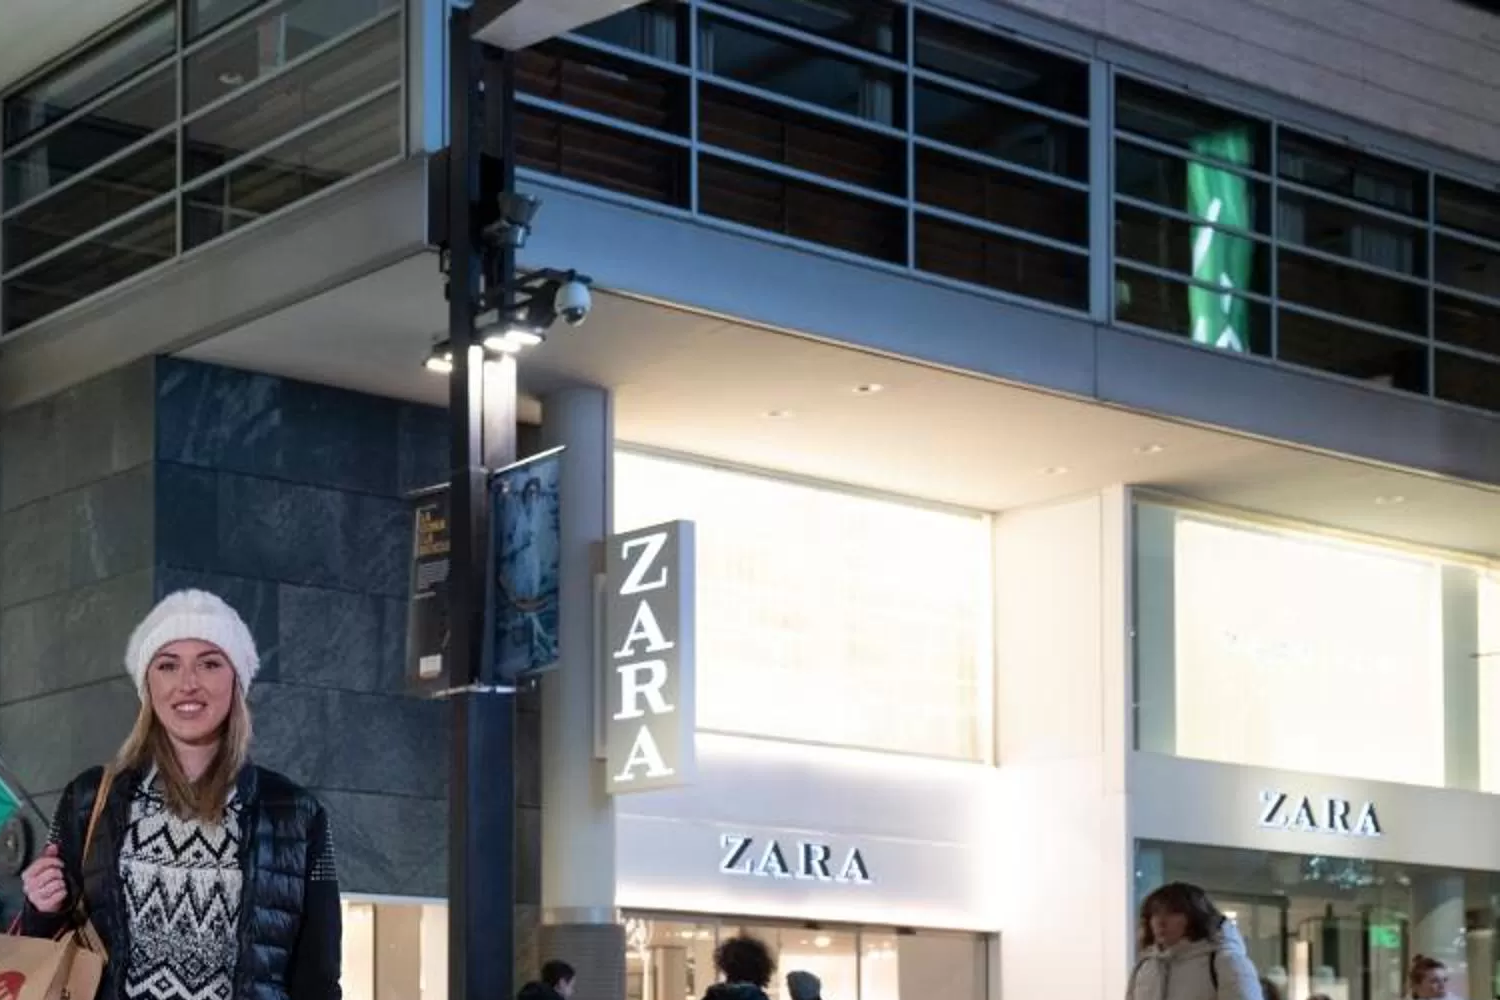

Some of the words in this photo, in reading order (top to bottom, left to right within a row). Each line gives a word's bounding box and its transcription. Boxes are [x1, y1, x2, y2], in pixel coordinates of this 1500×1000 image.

[612, 532, 674, 782] ZARA
[1258, 788, 1383, 837] ZARA
[720, 833, 872, 885] ZARA
